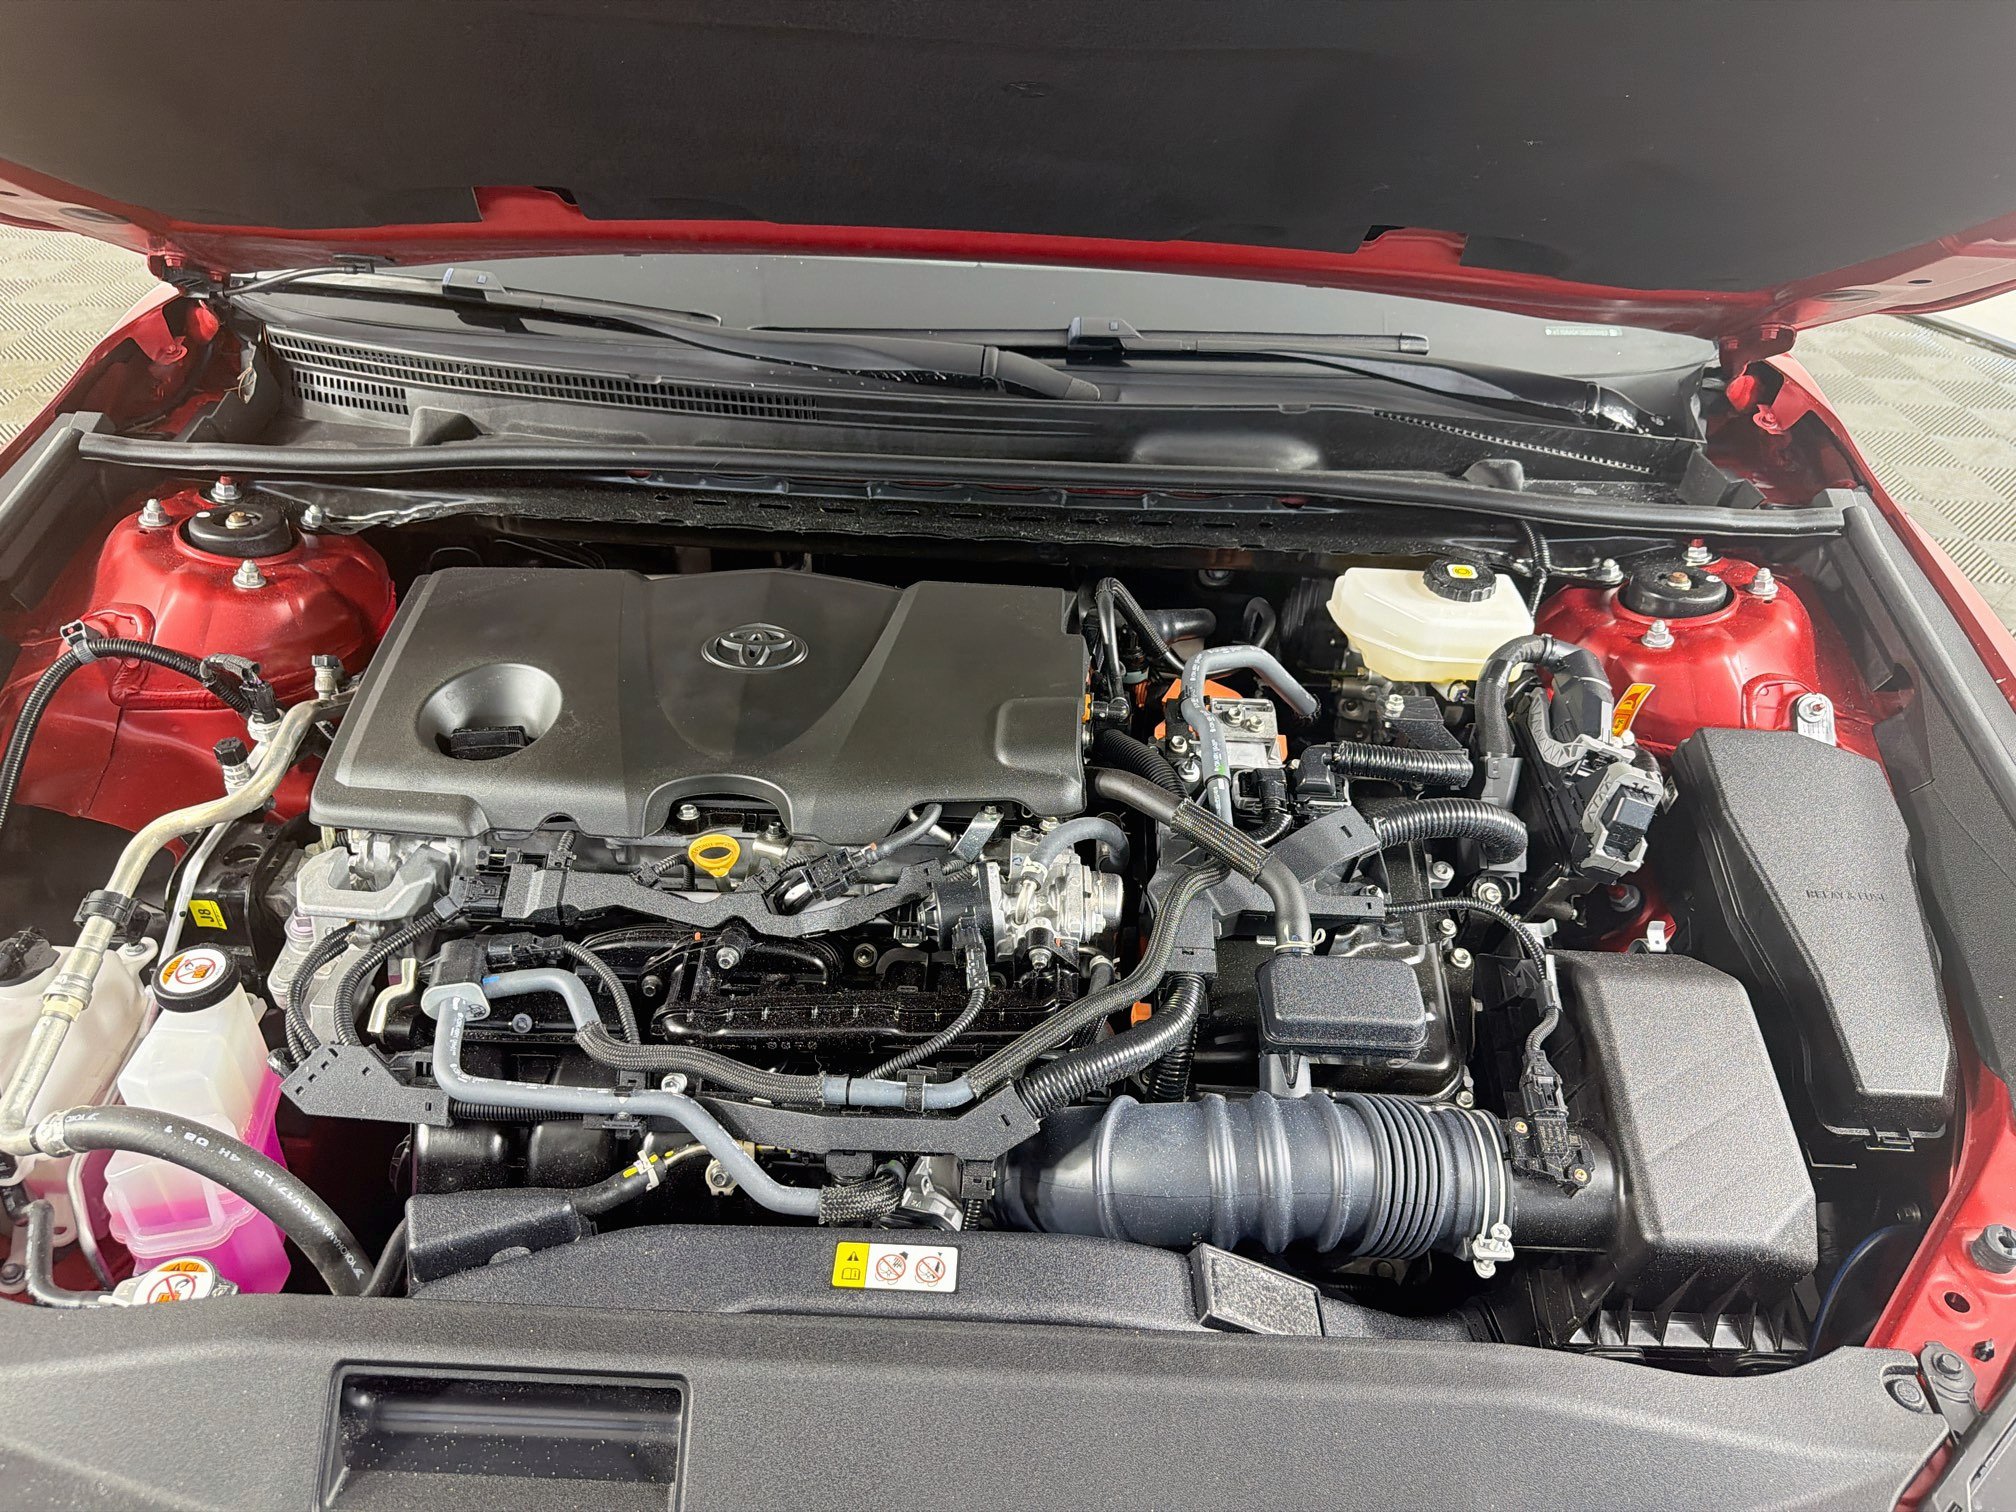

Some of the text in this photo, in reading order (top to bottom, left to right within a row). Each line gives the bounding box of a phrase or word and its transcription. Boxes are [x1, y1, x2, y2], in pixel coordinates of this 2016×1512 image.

[198, 909, 214, 922] J8
[218, 1147, 241, 1162] 4H
[254, 1169, 274, 1186] LP
[278, 1186, 320, 1222] ACV17
[323, 1225, 357, 1268] YOKOHAMA
